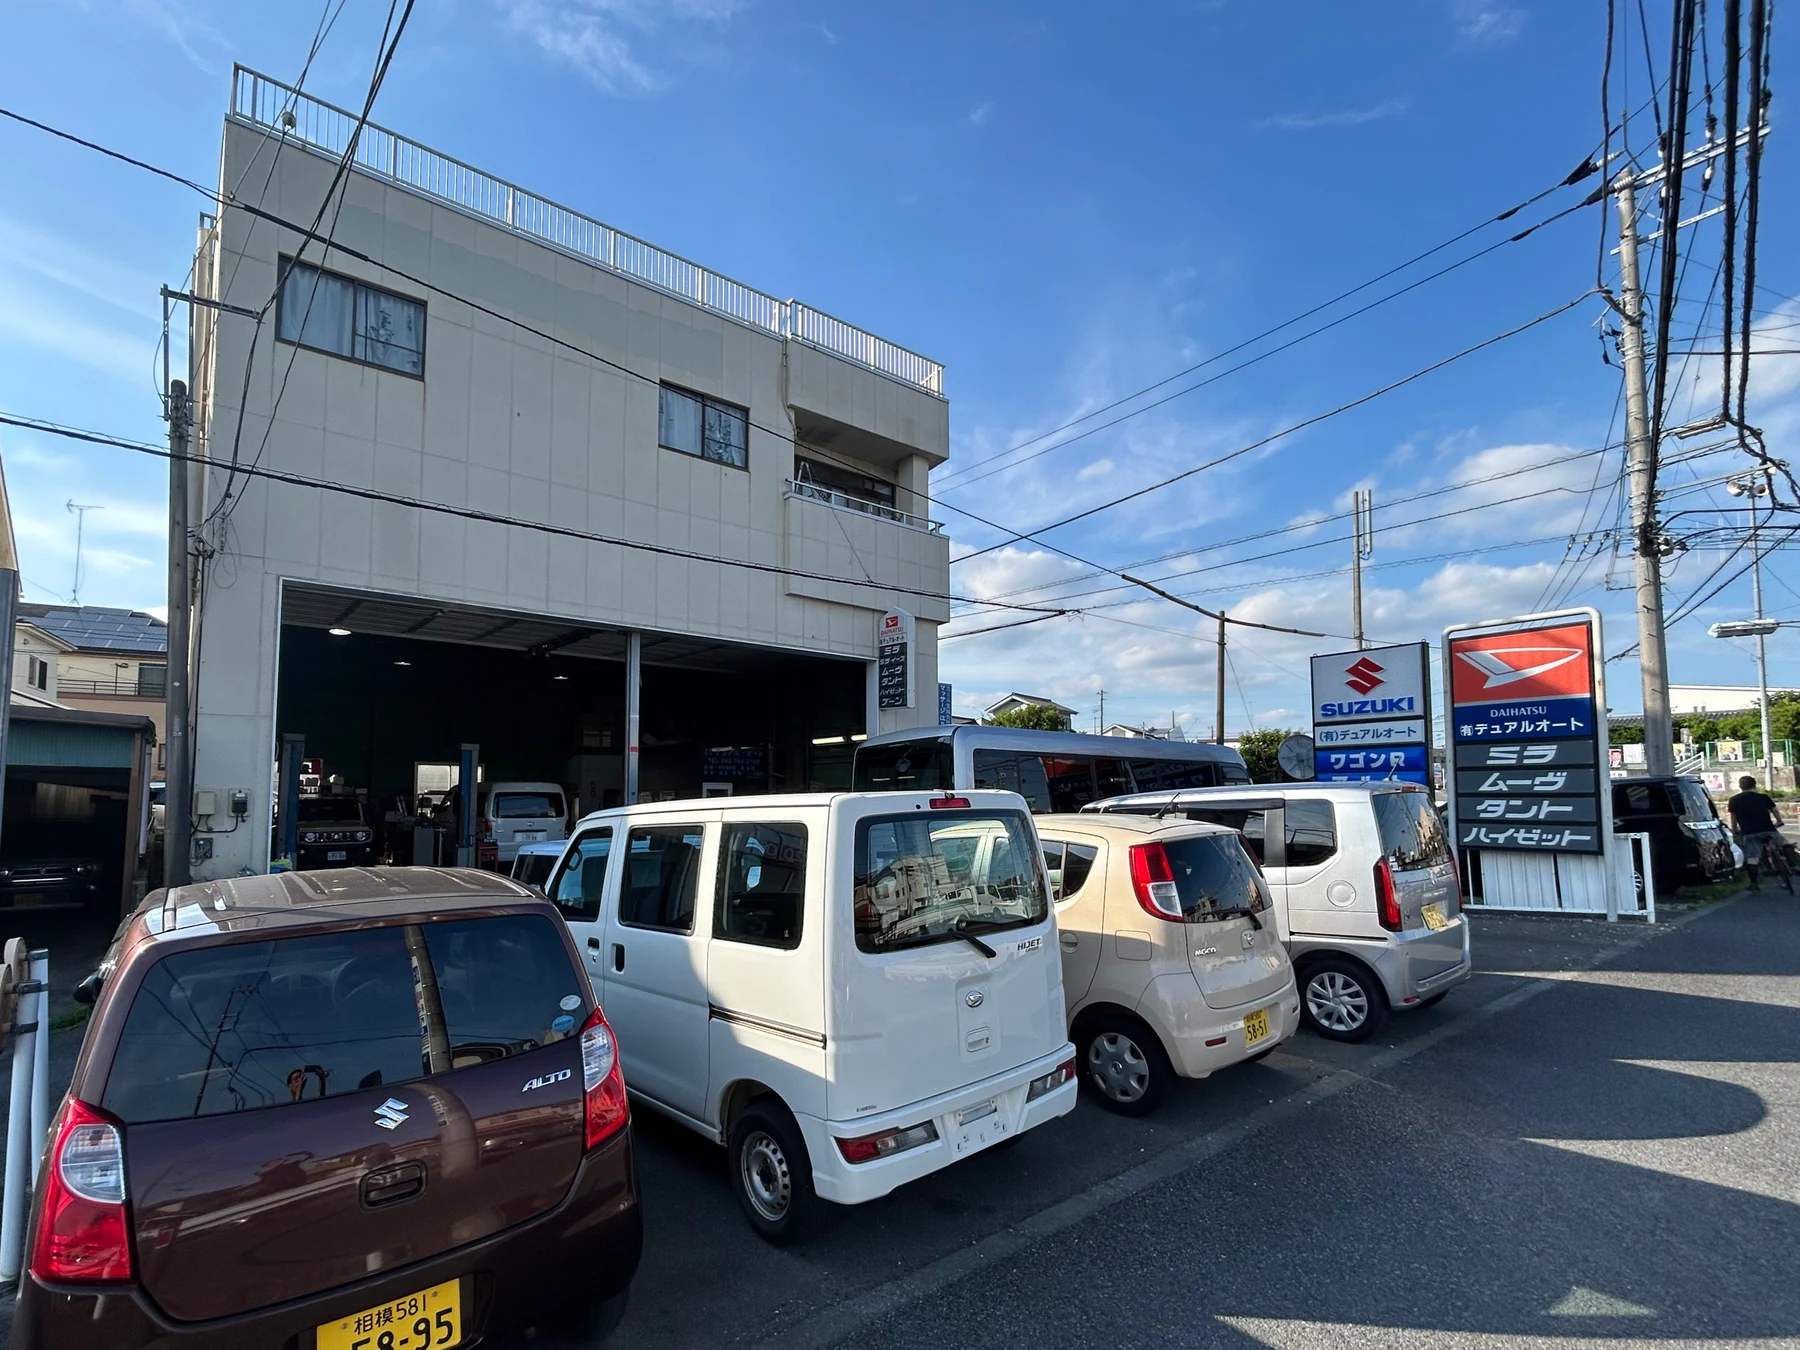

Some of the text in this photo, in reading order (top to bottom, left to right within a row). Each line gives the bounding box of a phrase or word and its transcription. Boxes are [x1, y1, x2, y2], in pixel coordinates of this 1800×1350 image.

[884, 645, 900, 655] ミラ
[882, 665, 902, 676] ムーヴ
[881, 676, 902, 686] タント
[1321, 696, 1414, 717] SUZUKI
[1490, 706, 1547, 718] DAIHATSU
[1320, 726, 1416, 742] (有)デュアルオート
[1330, 752, 1405, 769] ワゴンR
[1486, 745, 1558, 764] ミラ
[1478, 772, 1567, 791] ムーヴ
[1476, 800, 1573, 818] タント
[1463, 827, 1591, 846] ハイゼット
[1017, 937, 1041, 951] HIJET
[1246, 1019, 1268, 1041] 58-51
[522, 1069, 571, 1092] ALTO
